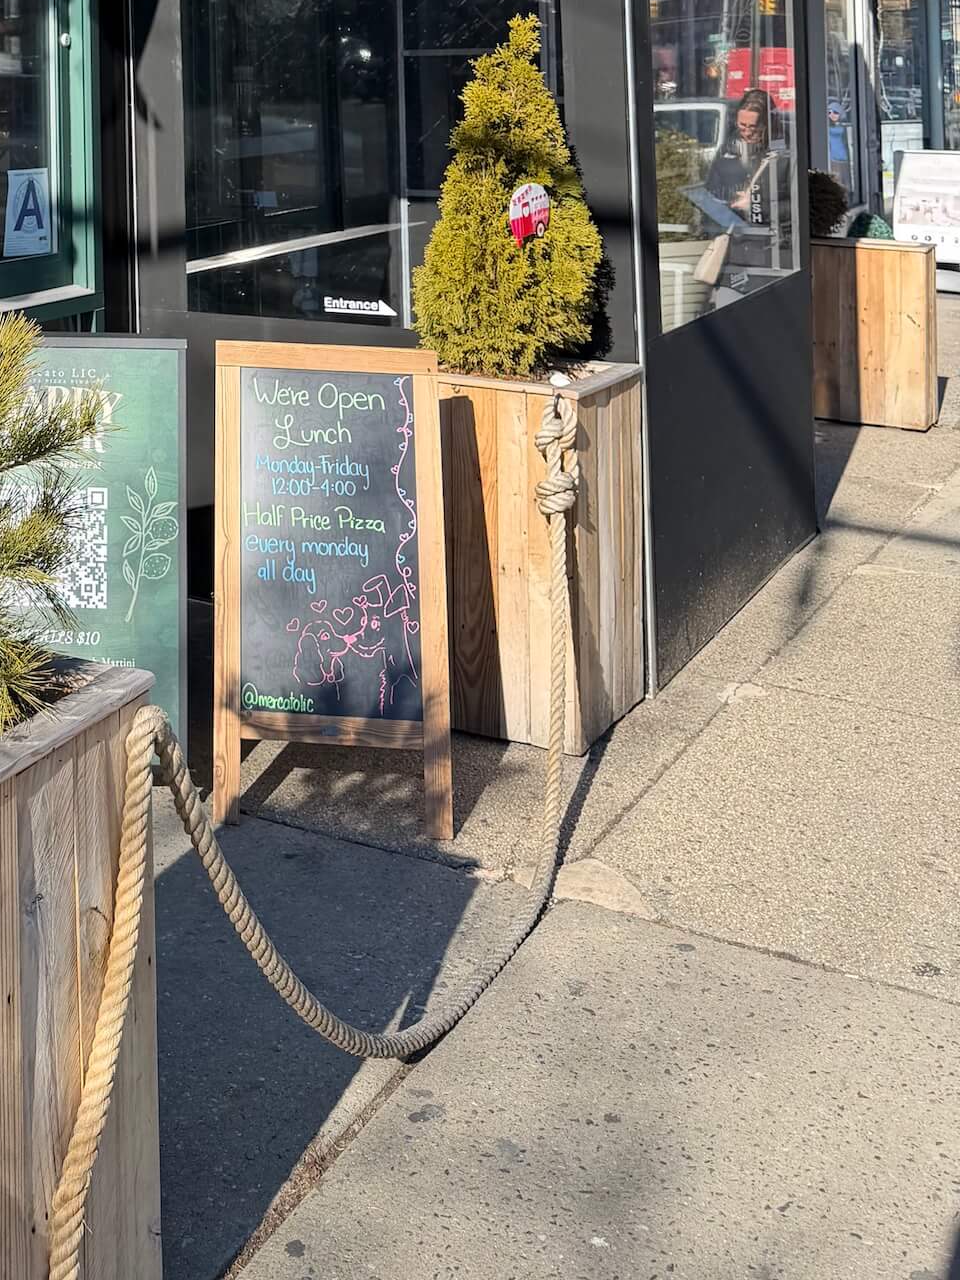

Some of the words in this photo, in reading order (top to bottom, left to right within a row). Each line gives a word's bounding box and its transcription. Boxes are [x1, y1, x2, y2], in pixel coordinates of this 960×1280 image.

[13, 179, 45, 232] A
[751, 184, 763, 223] PUSH
[323, 296, 379, 311] Entrance
[71, 368, 97, 379] LIC
[253, 377, 310, 407] We're
[318, 382, 386, 420] Open
[272, 414, 352, 450] Lunch
[255, 452, 370, 490] Monday-Friday
[271, 477, 356, 497] 12:00-4:00
[243, 500, 286, 528] Half
[290, 506, 332, 531] Price
[334, 505, 386, 534] Pizza
[245, 534, 296, 566] every
[301, 536, 369, 568] monday
[256, 560, 276, 581] all
[281, 561, 317, 595] day
[76, 631, 101, 646] $10
[242, 682, 315, 713] @mercatolic
